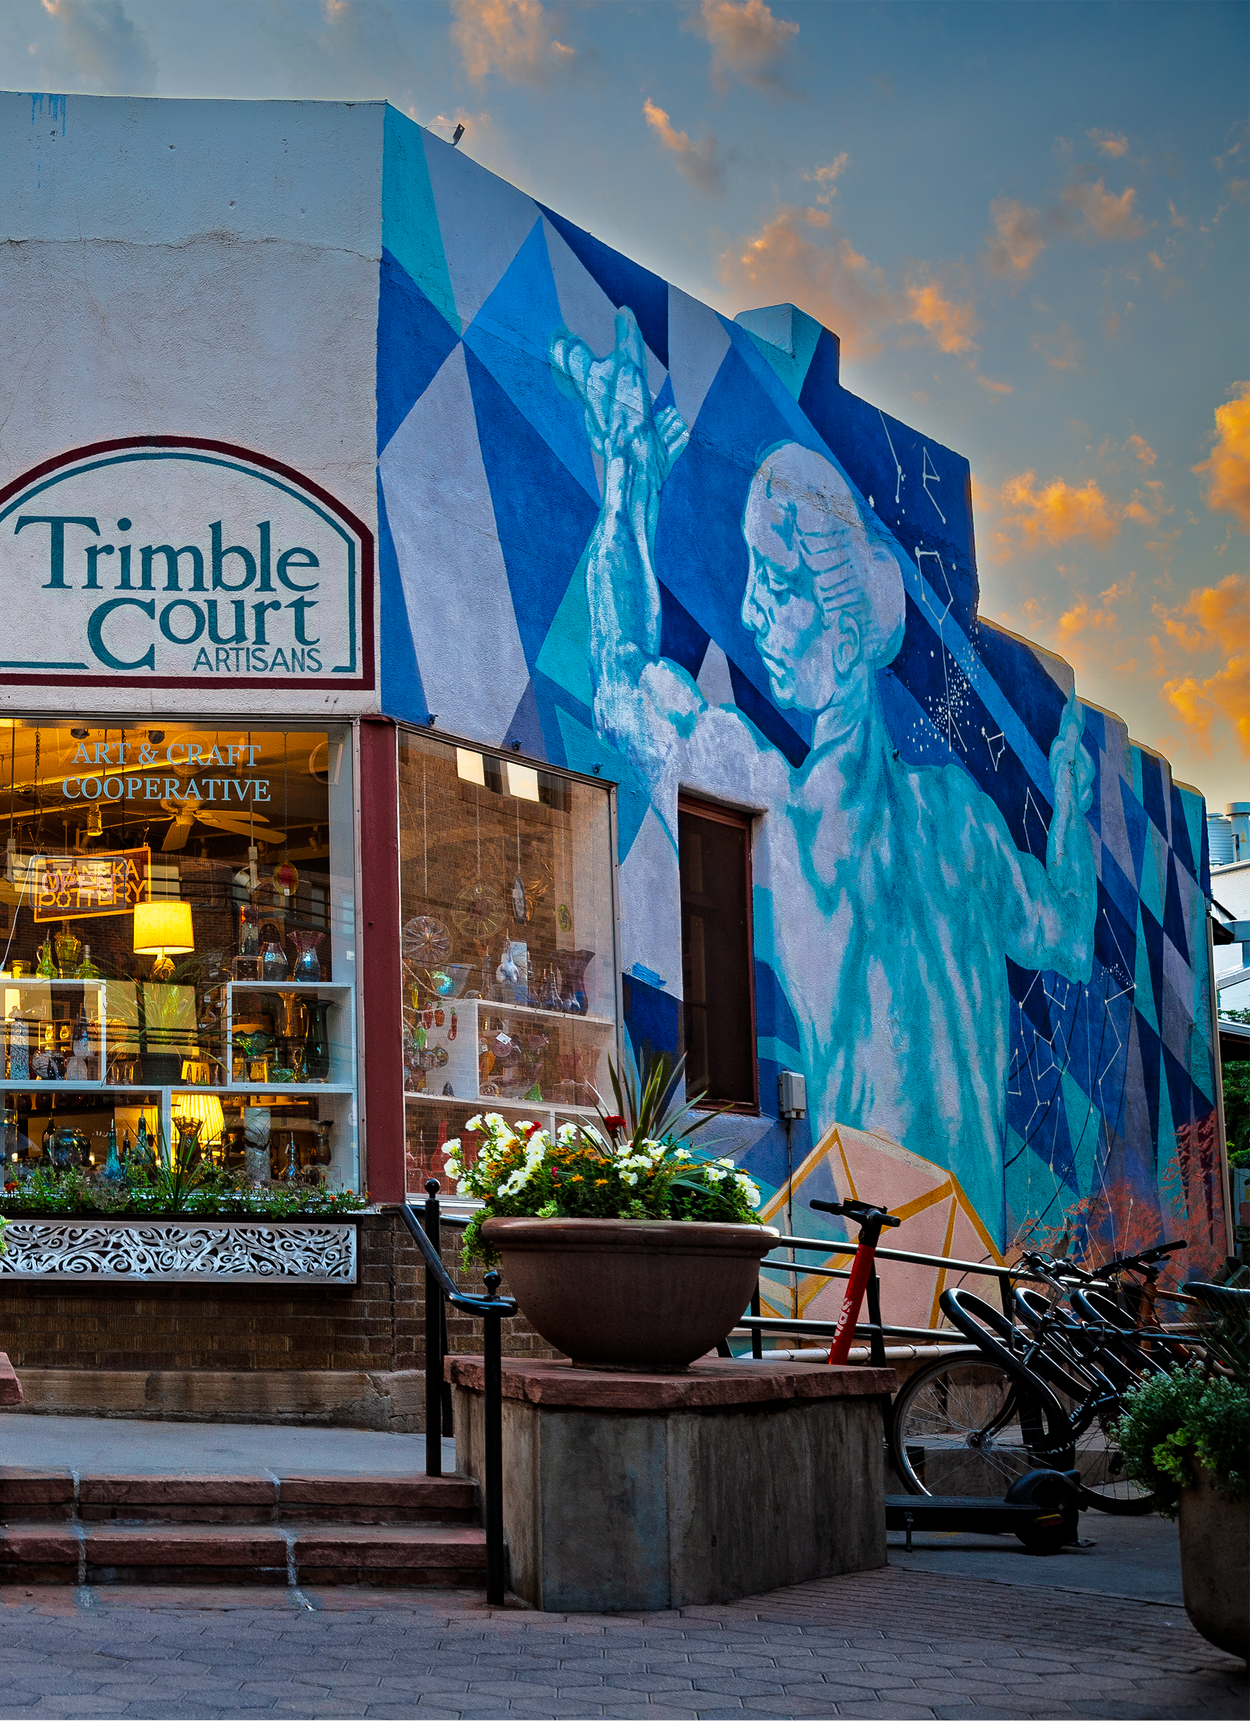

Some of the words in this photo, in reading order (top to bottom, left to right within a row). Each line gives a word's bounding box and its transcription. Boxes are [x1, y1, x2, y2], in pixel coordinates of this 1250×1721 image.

[14, 515, 320, 593] Trimble
[87, 595, 321, 671] Court
[192, 646, 323, 672] ARTISANS
[71, 742, 131, 764] ART
[138, 743, 159, 765] &
[166, 743, 261, 767] CRAFT
[62, 776, 271, 802] COOPERATIVE
[42, 873, 114, 895] OPEN
